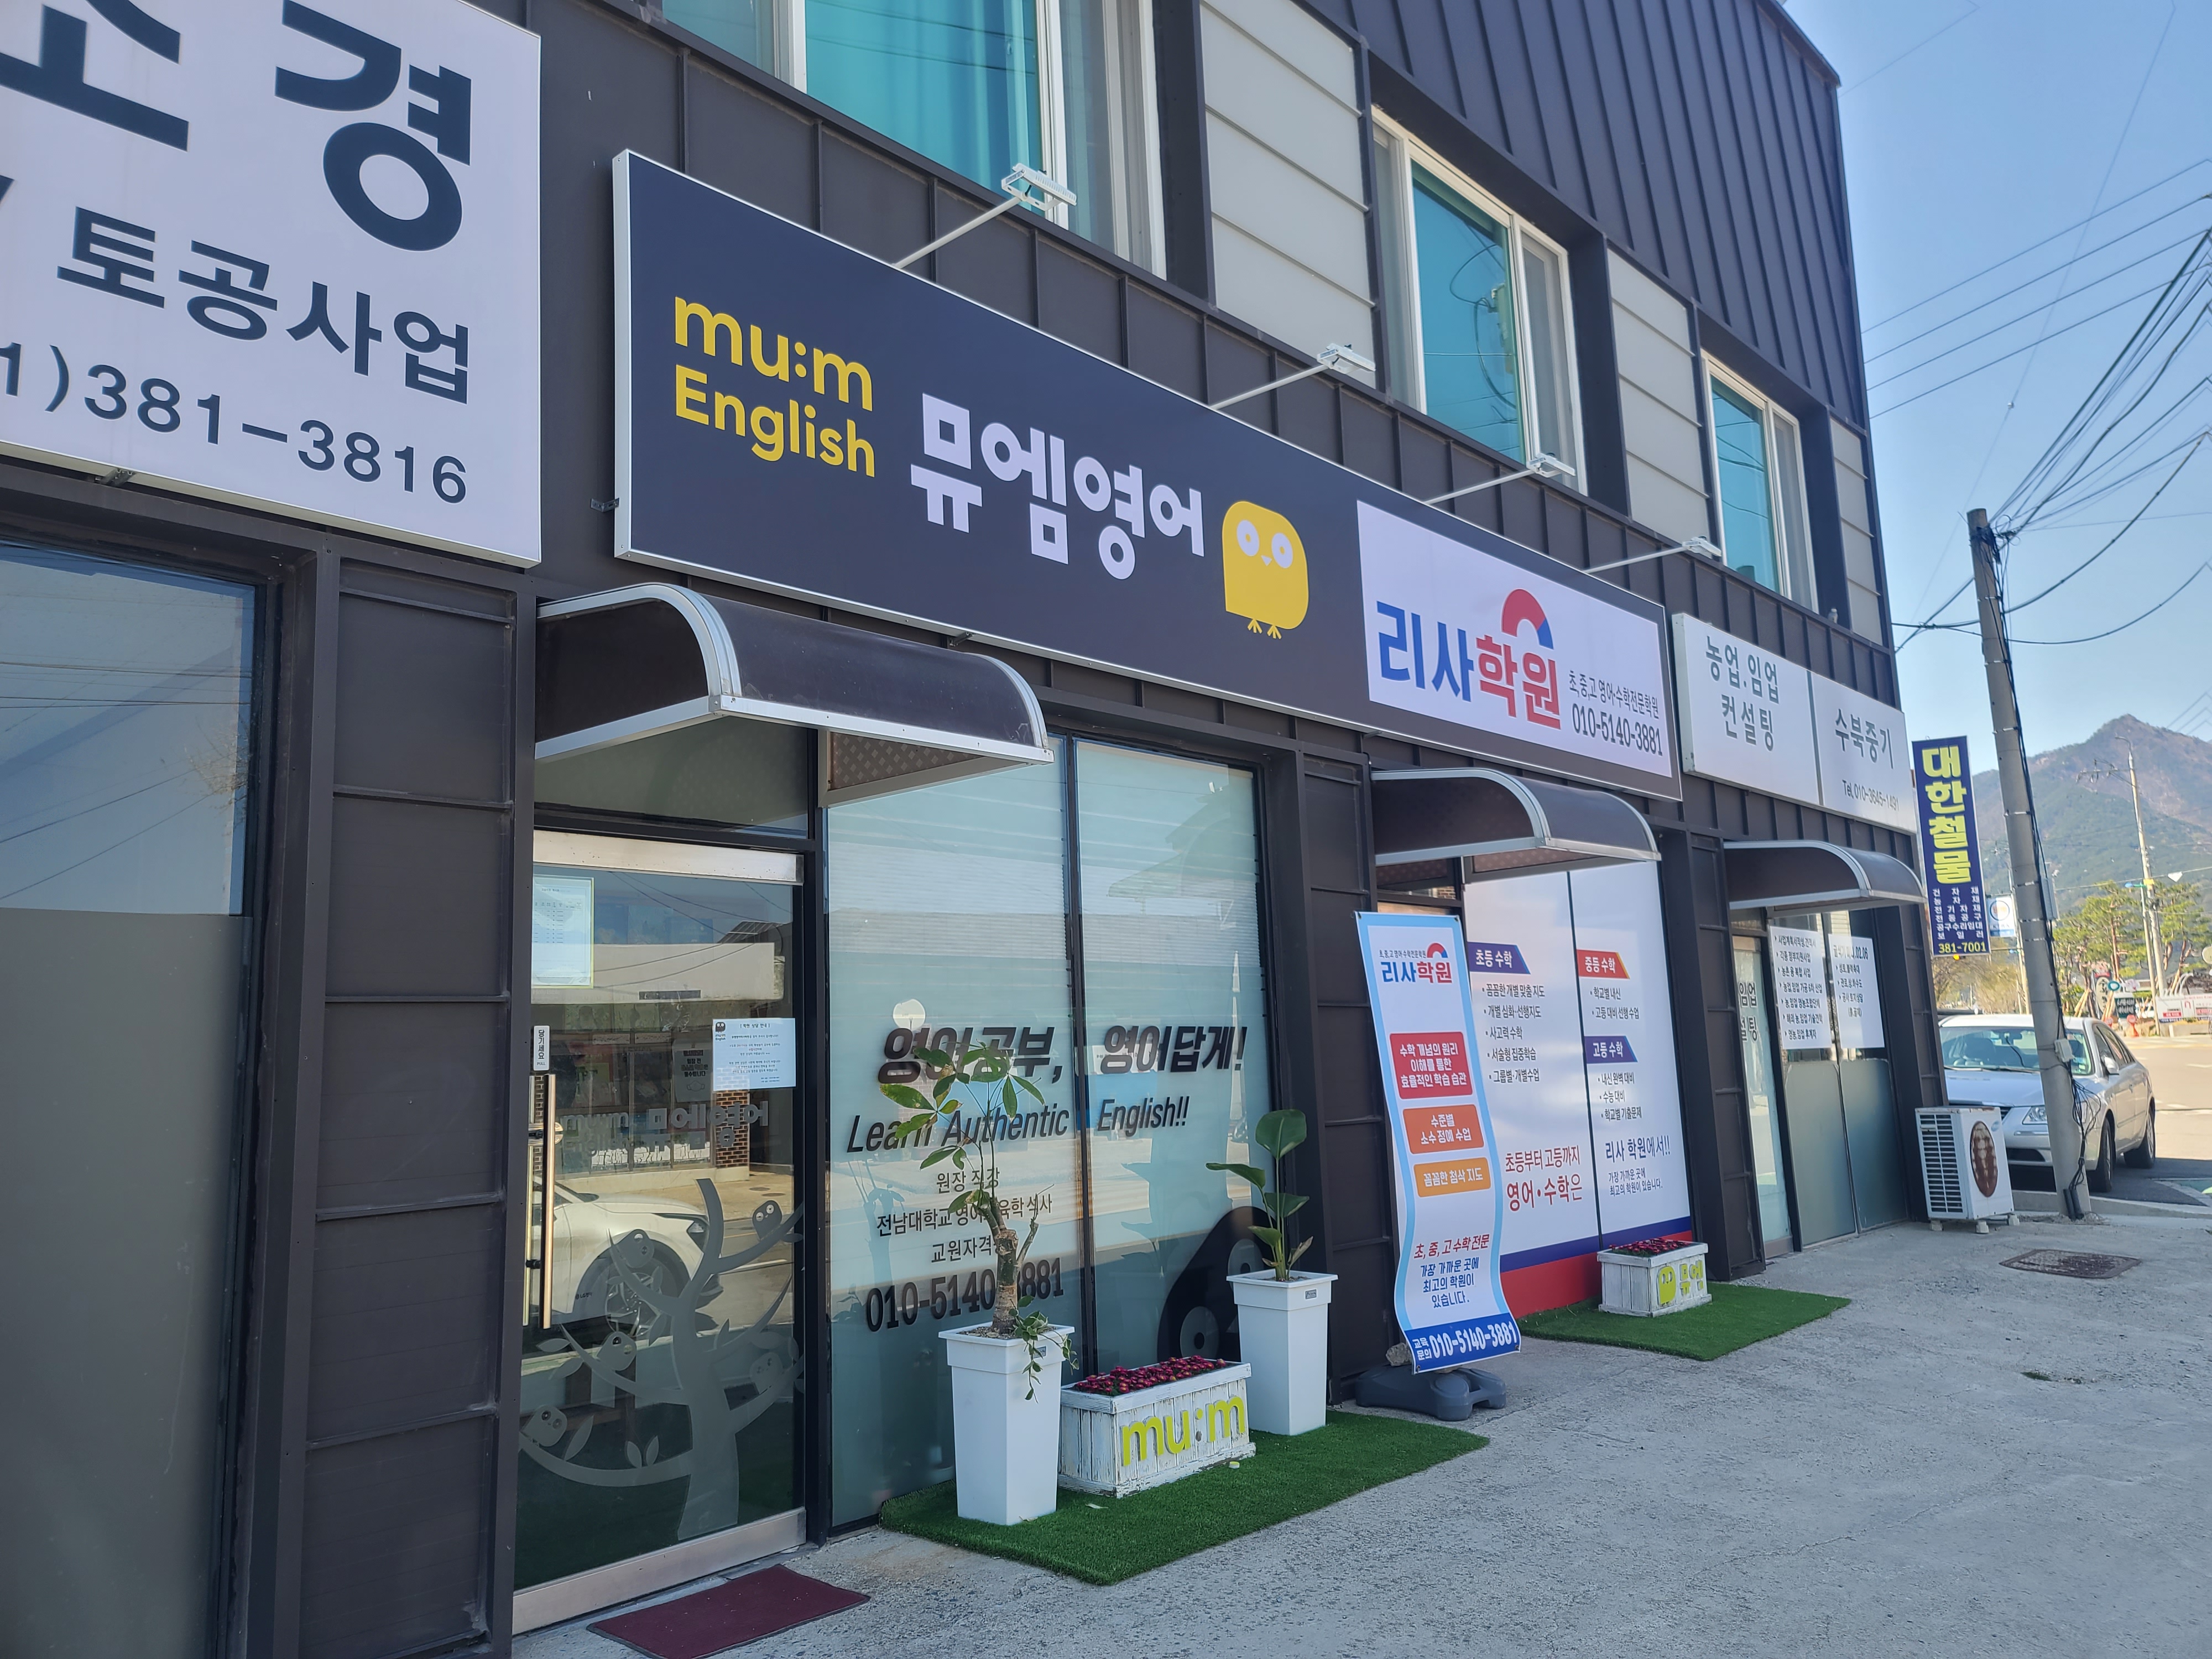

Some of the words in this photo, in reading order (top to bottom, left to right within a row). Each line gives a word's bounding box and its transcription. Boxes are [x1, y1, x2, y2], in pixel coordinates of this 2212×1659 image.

[57, 206, 468, 404] 토공사업
[675, 296, 873, 412] mu:m
[675, 364, 875, 477] English
[910, 393, 1204, 580] 뮤엠영어
[1376, 601, 1561, 730] 리사학원
[1572, 703, 1663, 757] 010-5140-3881
[1721, 693, 1775, 752] 컨설팅
[1835, 708, 1894, 769] 수북중기
[1921, 744, 1971, 885] 대한철물
[1938, 941, 1986, 953] 381-7001
[1476, 950, 1493, 967] 초등
[1495, 951, 1512, 968] 수학
[1585, 956, 1600, 973] 중등
[1601, 957, 1615, 974] 수학
[1380, 961, 1452, 983] 리사학원
[1486, 983, 1505, 997] 꼼꼼한
[1506, 984, 1519, 998] 개별
[1520, 984, 1532, 998] 맞춤
[1533, 985, 1545, 998] 지도
[1593, 987, 1610, 1000] 학교별
[1610, 987, 1621, 1000] 내신
[1488, 1004, 1501, 1019] 개별
[1595, 1006, 1606, 1019] 고등
[1607, 1007, 1618, 1019] 대비
[1618, 1006, 1629, 1019] 선행
[1629, 1007, 1640, 1020] 수업
[1490, 1026, 1509, 1040] 사고력
[1510, 1026, 1522, 1040] 수학
[1100, 1025, 1248, 1074] 영어답게!
[1400, 1044, 1416, 1057] 수학
[1416, 1043, 1441, 1056] 개념의
[1442, 1042, 1458, 1056] 원리
[1491, 1047, 1511, 1062] 서술형
[1511, 1047, 1536, 1061] 집중학습
[1593, 1042, 1608, 1058] 고등
[1609, 1041, 1623, 1058] 수학
[1410, 1058, 1436, 1072] 이해를
[1401, 1074, 1433, 1088] 효율적인
[1433, 1073, 1451, 1087] 학습
[1451, 1072, 1467, 1086] 습관
[1601, 1072, 1613, 1086] 내신
[1613, 1072, 1624, 1085] 완벽
[1624, 1072, 1635, 1084] 대비
[1603, 1091, 1614, 1104] 수능
[1614, 1090, 1625, 1102] 대비
[941, 1103, 1069, 1147] Authentic
[1098, 1095, 1190, 1137] English!!
[1431, 1113, 1455, 1128] 수준별
[1604, 1108, 1621, 1122] 학교별
[1621, 1106, 1642, 1120] 기출문제
[1421, 1130, 1437, 1145] 소수
[1455, 1128, 1472, 1141] 수업
[1505, 1149, 1543, 1173] 초등부터
[1545, 1145, 1580, 1168] 고등까지
[1605, 1140, 1625, 1163] 리사
[1627, 1135, 1671, 1160] 학원에서!!
[936, 1171, 967, 1194] 원장
[1423, 1171, 1448, 1187] 꼼꼼한
[1449, 1169, 1465, 1183] 첨삭
[1467, 1167, 1483, 1181] 지도
[1608, 1171, 1619, 1184] 가장
[1620, 1168, 1635, 1182] 가까운
[1636, 1167, 1646, 1180] 곳에
[1610, 1183, 1625, 1197] 최고의
[1626, 1181, 1641, 1194] 학원이
[1642, 1177, 1663, 1192] 있습니다.
[877, 1207, 953, 1237] 전남대학교
[956, 1196, 1024, 1226] 영어육학
[931, 1235, 998, 1263] 교원자격
[1421, 1264, 1436, 1277] 가장
[1438, 1260, 1462, 1274] 가까운
[1464, 1257, 1479, 1271] 곳에
[1679, 1259, 1704, 1295] 뮤엠
[1423, 1277, 1448, 1293] 최고의
[1450, 1273, 1474, 1288] 학원이
[865, 1257, 1064, 1332] 010-5140881
[1432, 1290, 1470, 1308] 있습니다.
[1412, 1337, 1430, 1349] 교육
[1429, 1321, 1517, 1358] 010-5140-3881
[1417, 1348, 1432, 1361] 문의
